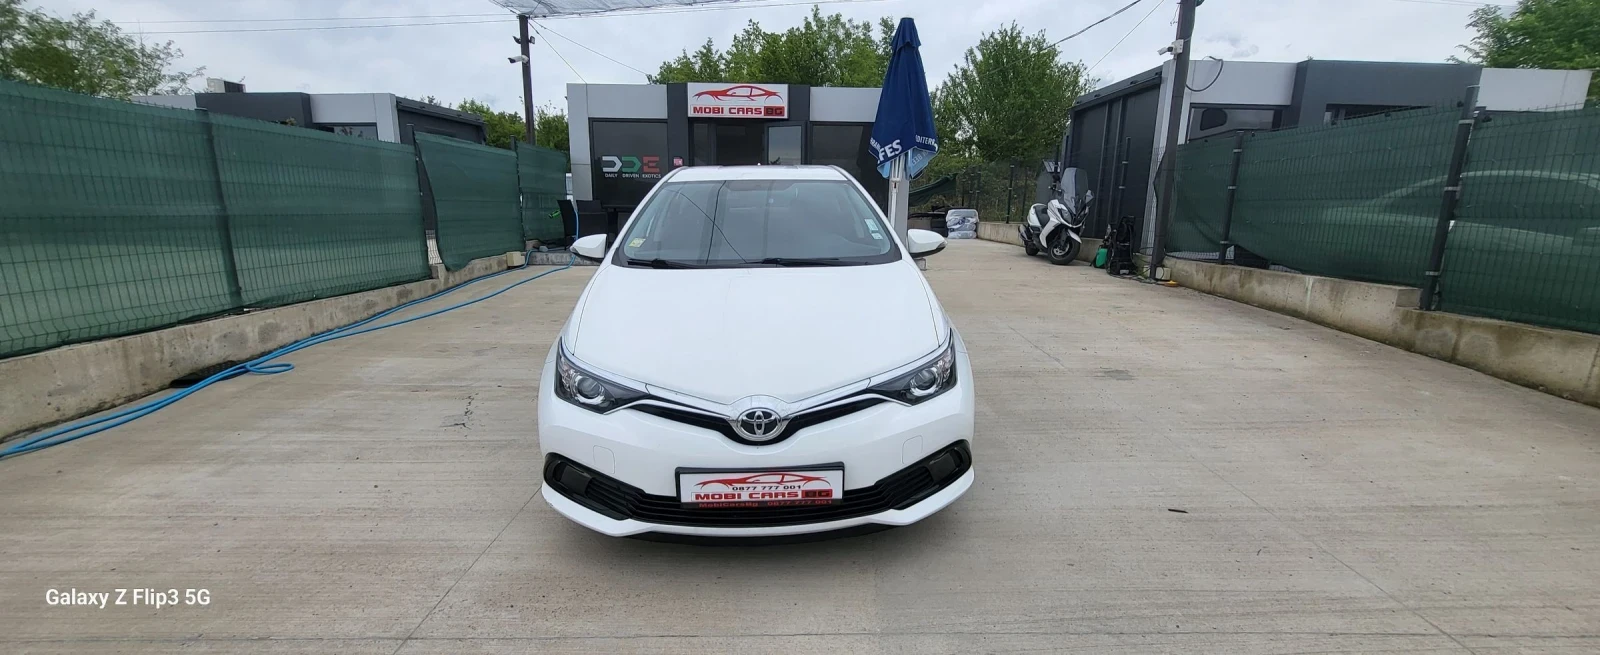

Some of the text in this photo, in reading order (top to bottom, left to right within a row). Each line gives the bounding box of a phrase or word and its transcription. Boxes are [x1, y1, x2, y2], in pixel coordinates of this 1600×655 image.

[693, 106, 783, 115] MOBI CARS BG
[878, 139, 903, 162] FES
[695, 490, 831, 501] MOBI CARS BG
